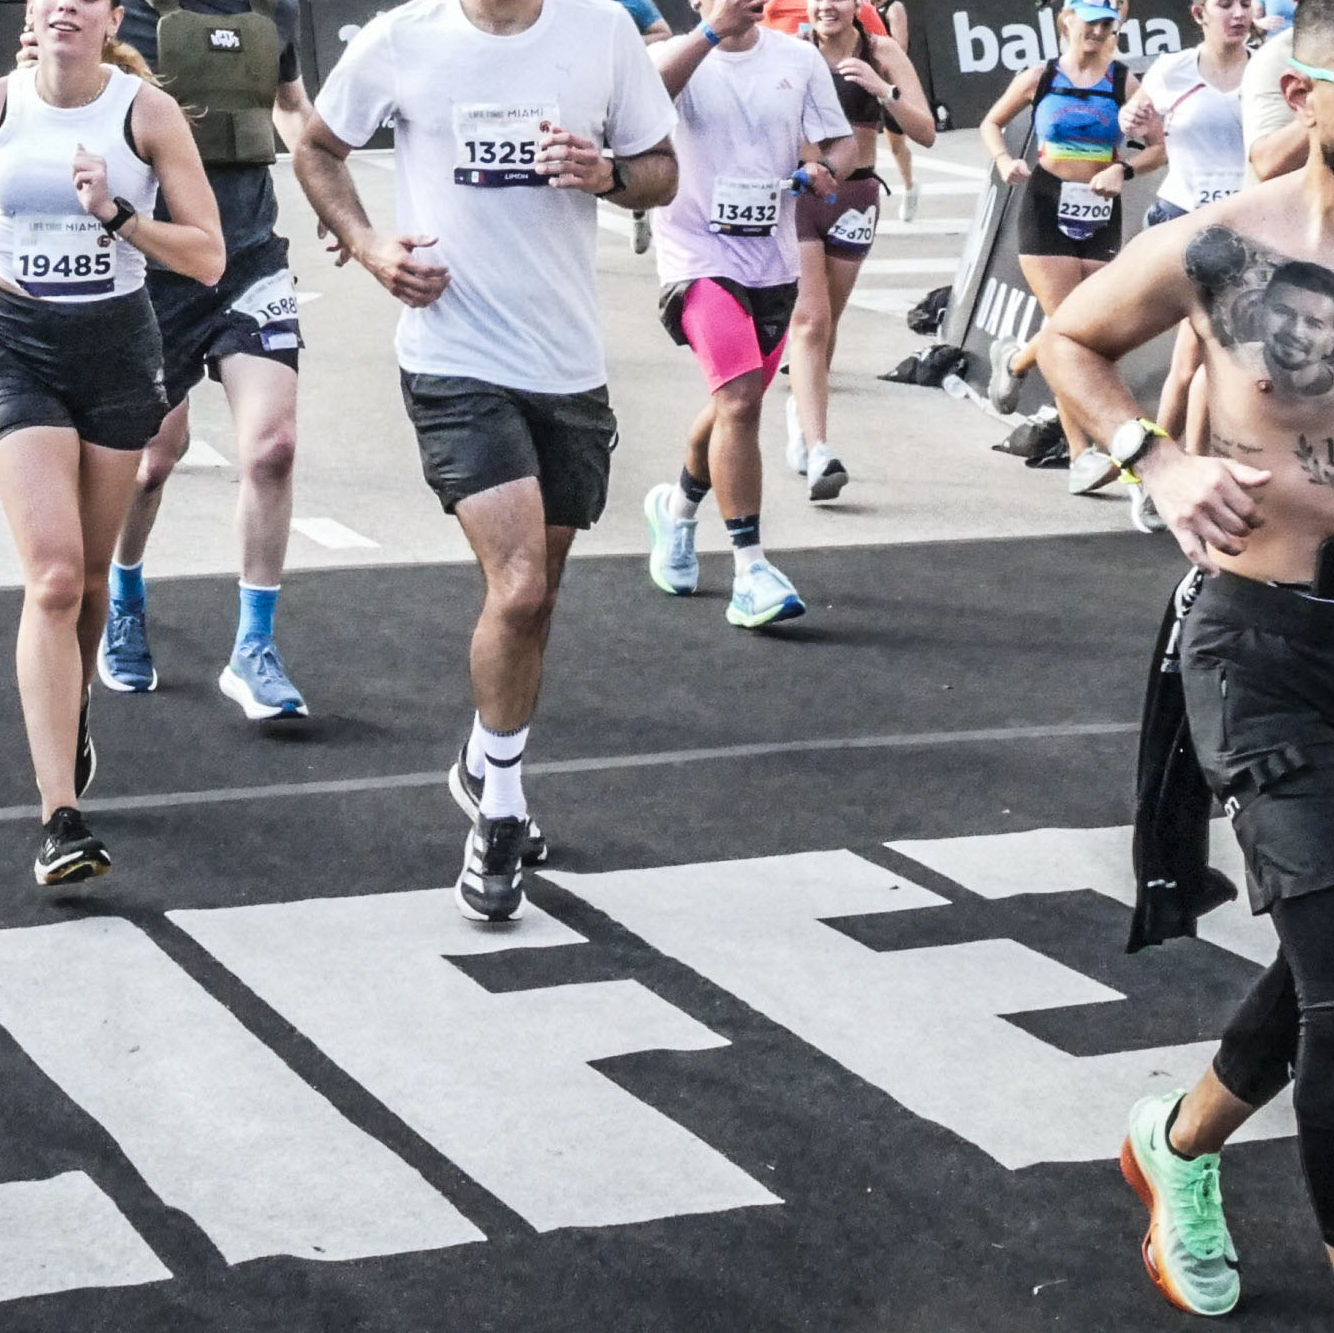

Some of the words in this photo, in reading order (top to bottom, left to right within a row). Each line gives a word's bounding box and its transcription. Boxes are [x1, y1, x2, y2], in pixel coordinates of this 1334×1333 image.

[953, 7, 1181, 73] bala
[508, 106, 544, 117] MIAMI
[465, 140, 541, 164] 1325
[717, 203, 777, 222] 13432
[1060, 202, 1111, 218] 22700
[66, 222, 101, 232] MIAMI
[19, 253, 112, 278] 19485
